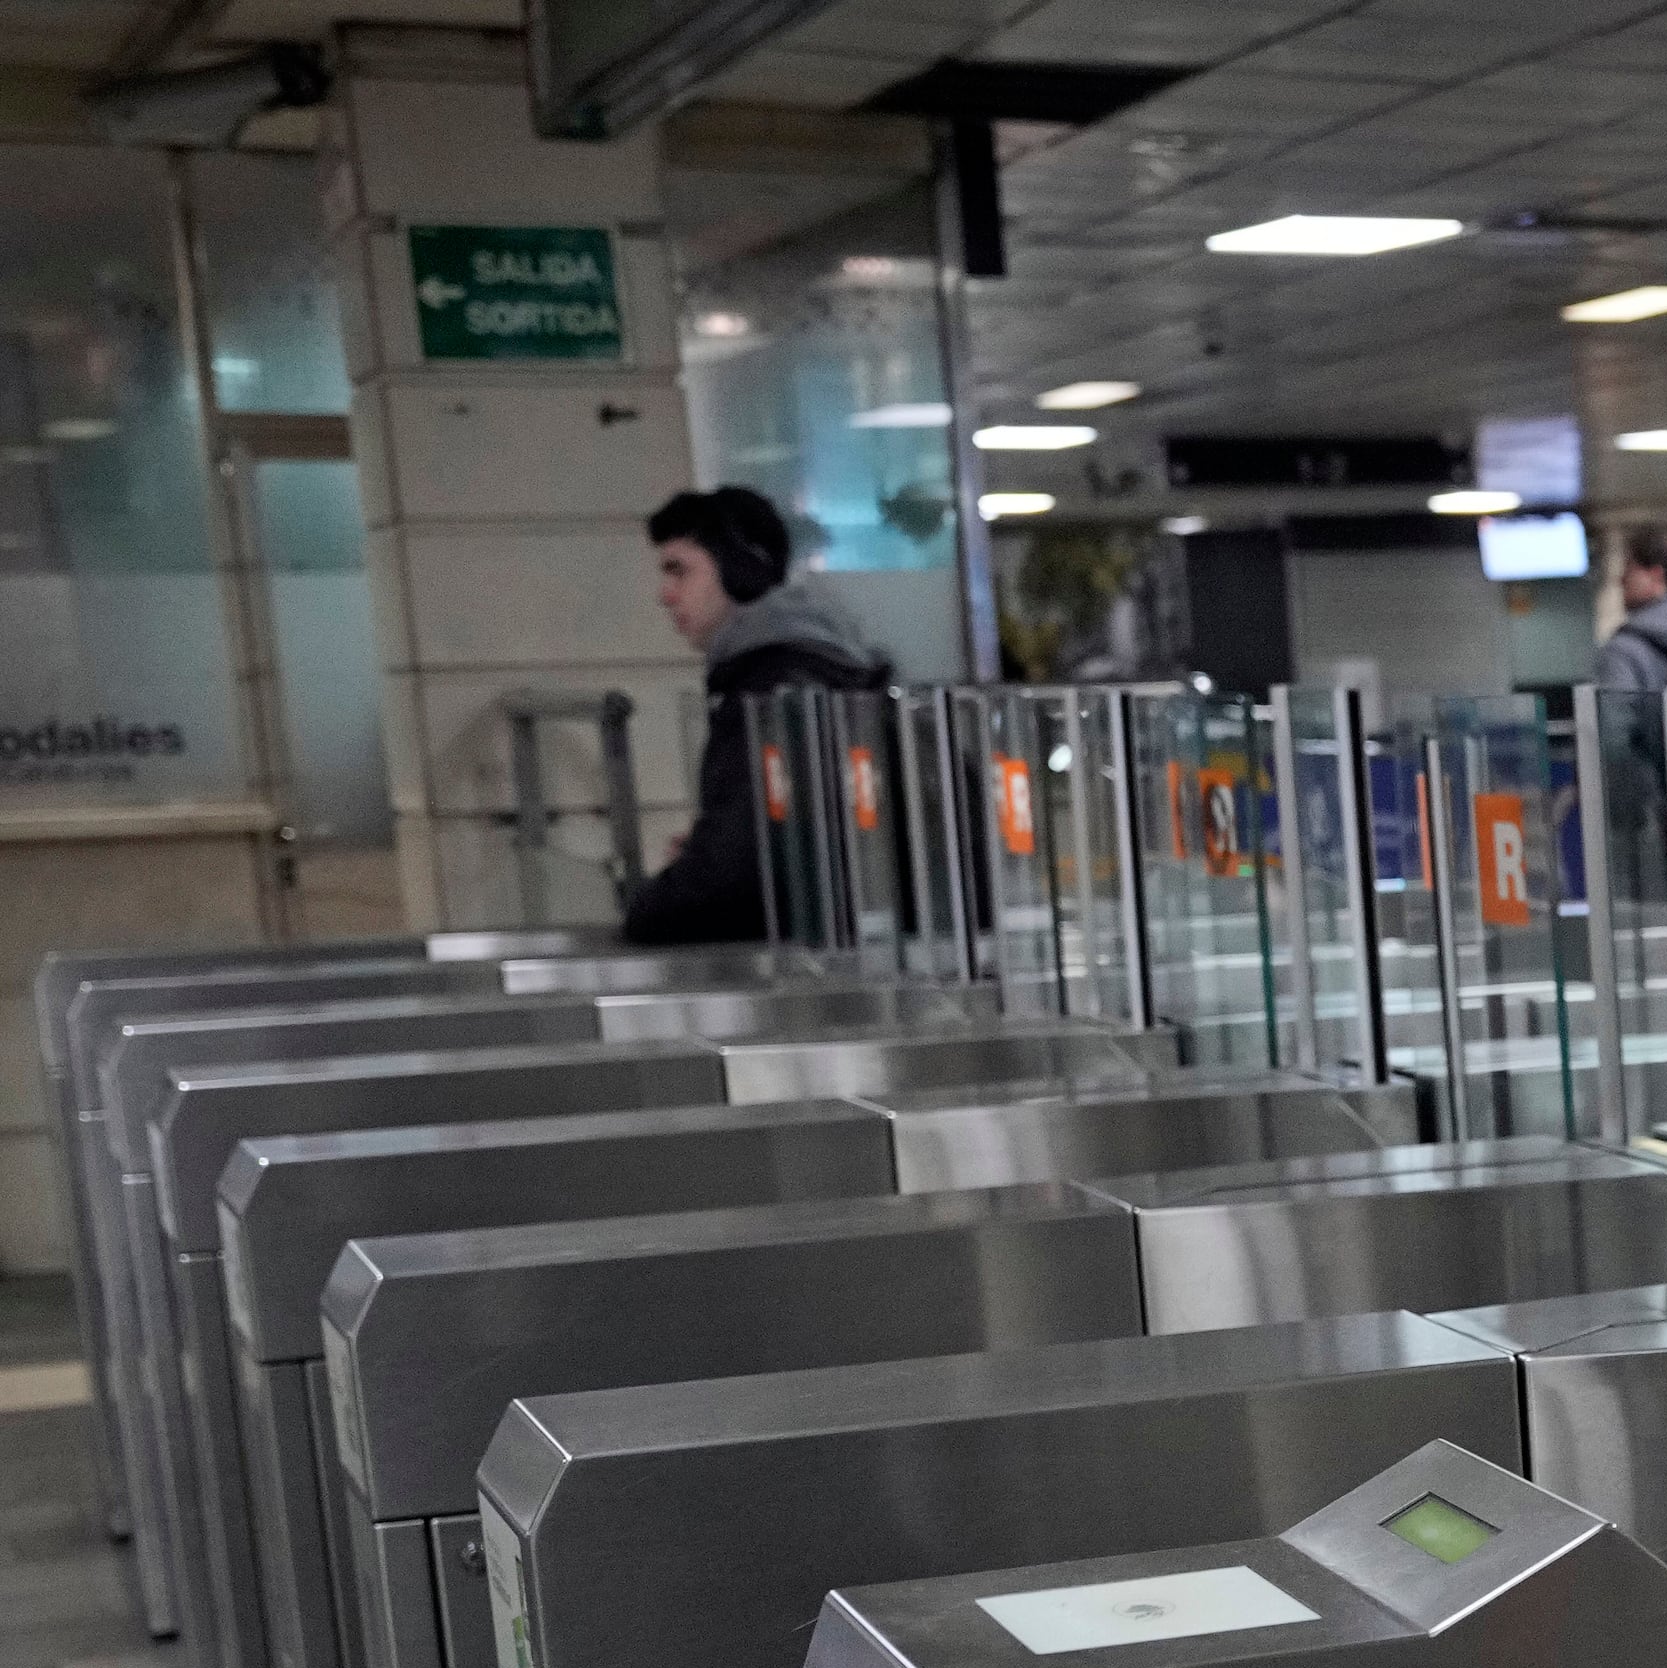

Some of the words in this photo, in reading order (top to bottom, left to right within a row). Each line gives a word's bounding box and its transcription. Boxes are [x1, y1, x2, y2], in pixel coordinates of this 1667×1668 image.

[473, 250, 600, 284] SALIDA
[466, 301, 618, 336] SORTIDA
[1493, 820, 1527, 901] R
